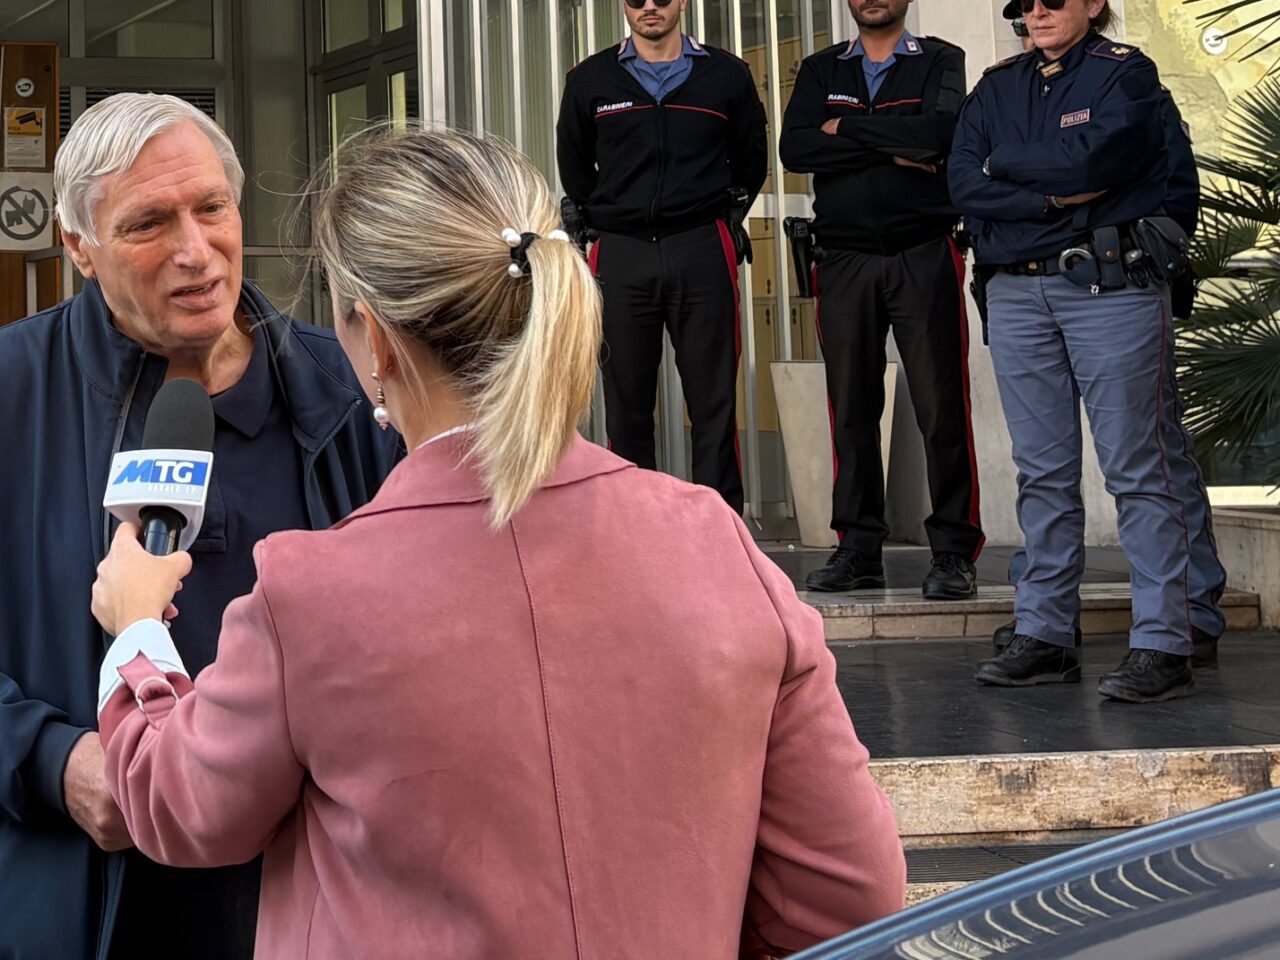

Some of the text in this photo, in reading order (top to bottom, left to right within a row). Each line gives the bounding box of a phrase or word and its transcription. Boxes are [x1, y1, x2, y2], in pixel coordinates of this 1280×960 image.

[596, 101, 633, 113] CARABINIERI
[1062, 111, 1088, 124] POLIZIA
[112, 459, 196, 485] MTG
